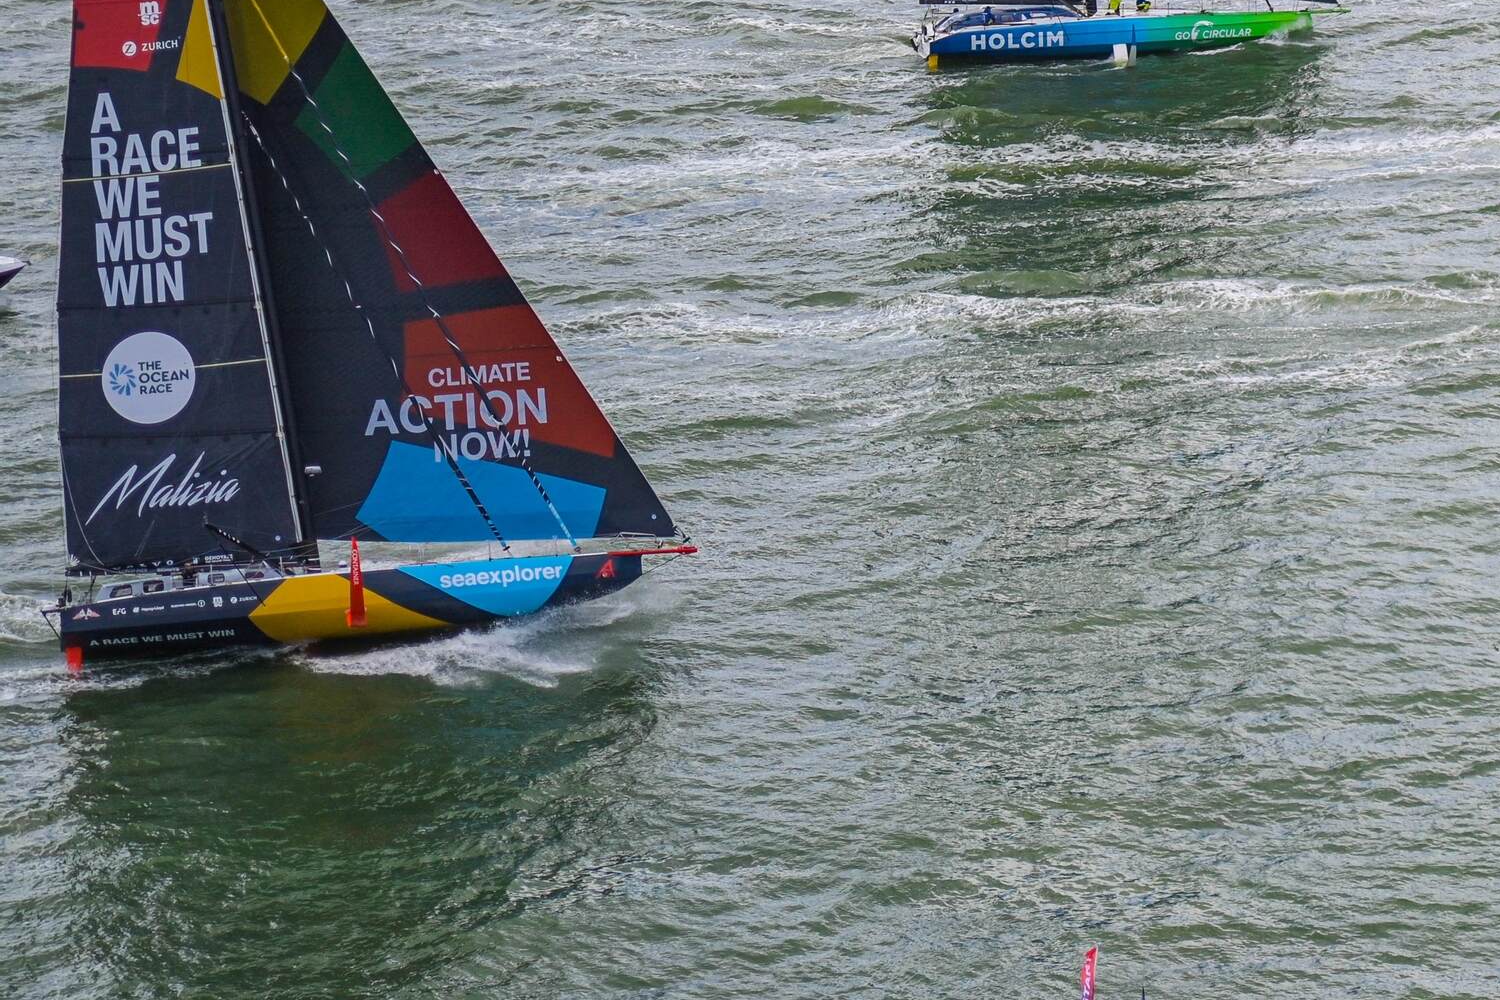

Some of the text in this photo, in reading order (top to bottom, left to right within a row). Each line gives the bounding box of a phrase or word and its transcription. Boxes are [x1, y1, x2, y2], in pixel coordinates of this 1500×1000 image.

[141, 39, 179, 52] ZURICH
[970, 30, 1064, 51] HOLCIM
[1174, 28, 1252, 41] GO CIRCULAR
[90, 92, 121, 134] A
[90, 127, 202, 177] RACE
[93, 174, 162, 220] WE
[95, 211, 213, 263] MUST
[97, 260, 185, 307] WIN
[138, 360, 162, 371] THE
[138, 368, 190, 383] OCEAN
[428, 362, 531, 388] CLIMATE
[139, 383, 173, 395] RACE
[364, 387, 548, 437] ACTION
[433, 429, 531, 463] NOW!
[84, 450, 241, 526] Malizia
[440, 563, 563, 590] seaexplorer
[89, 628, 236, 648] A RACE WE MUST WIN
